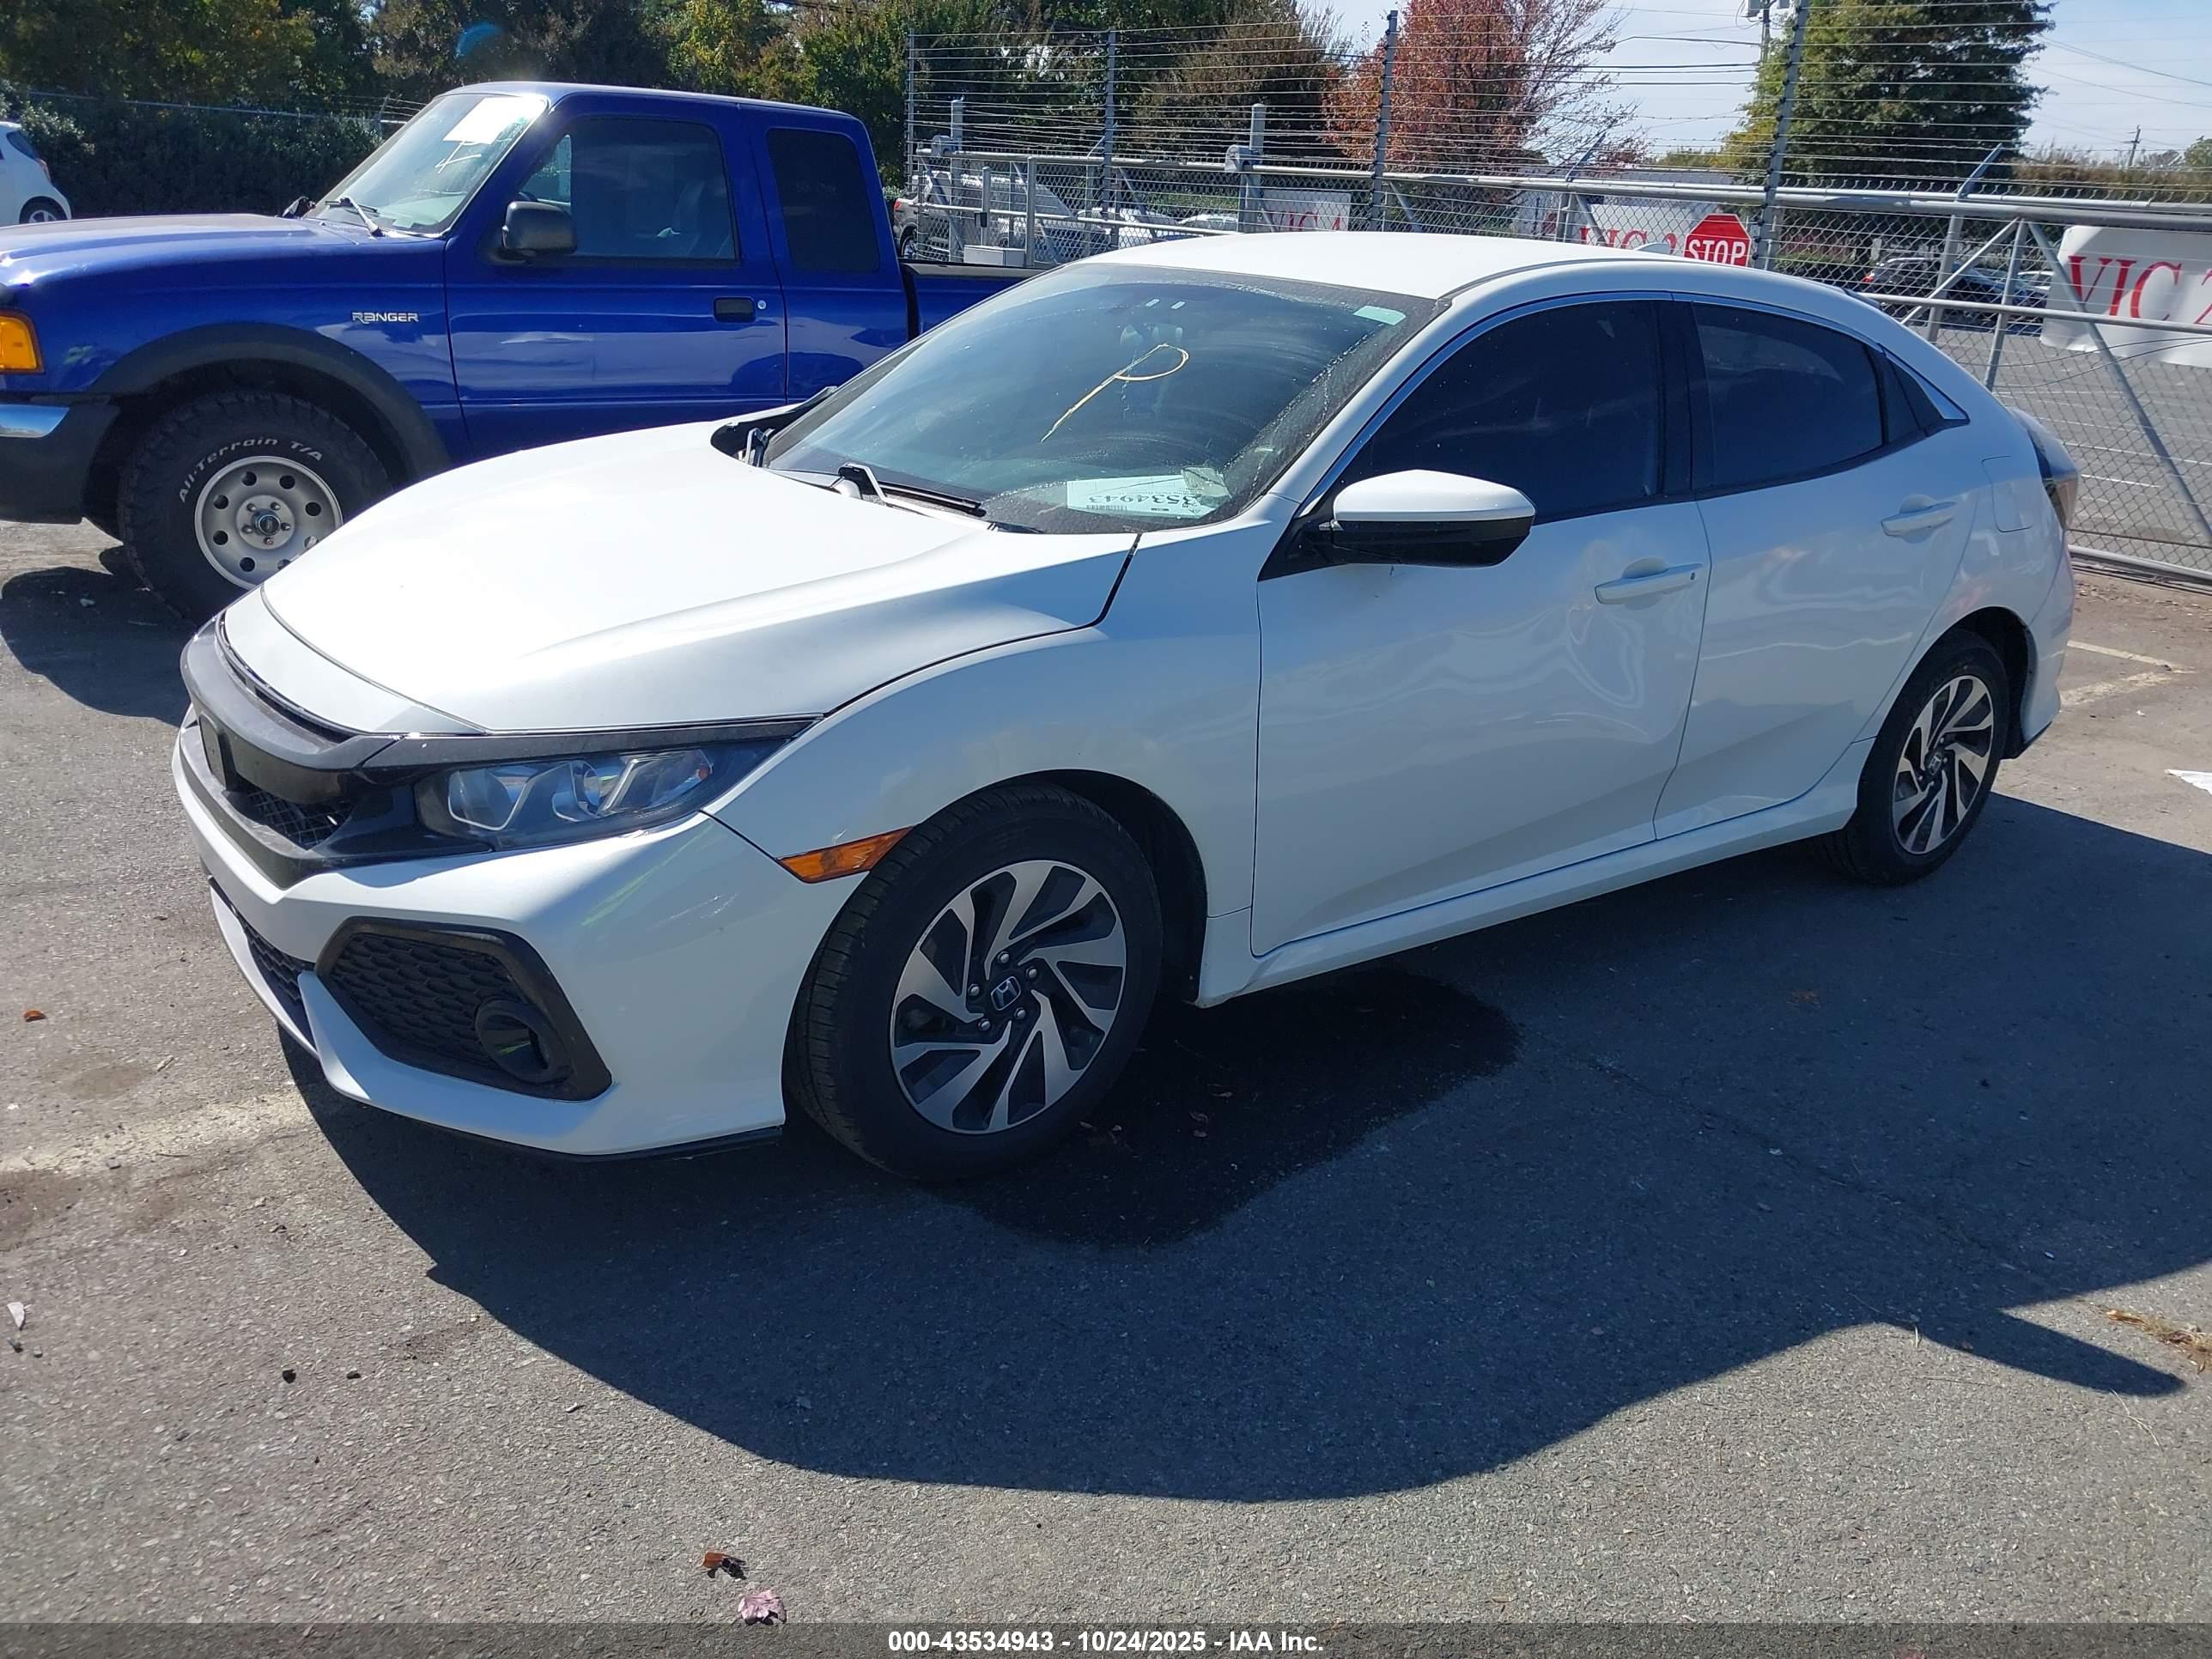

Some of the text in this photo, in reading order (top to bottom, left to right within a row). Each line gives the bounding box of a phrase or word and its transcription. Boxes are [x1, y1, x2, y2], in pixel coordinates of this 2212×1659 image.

[1688, 239, 1746, 264] STOP
[2068, 256, 2182, 320] VIC
[352, 312, 419, 325] RANGER
[290, 441, 323, 461] T/A
